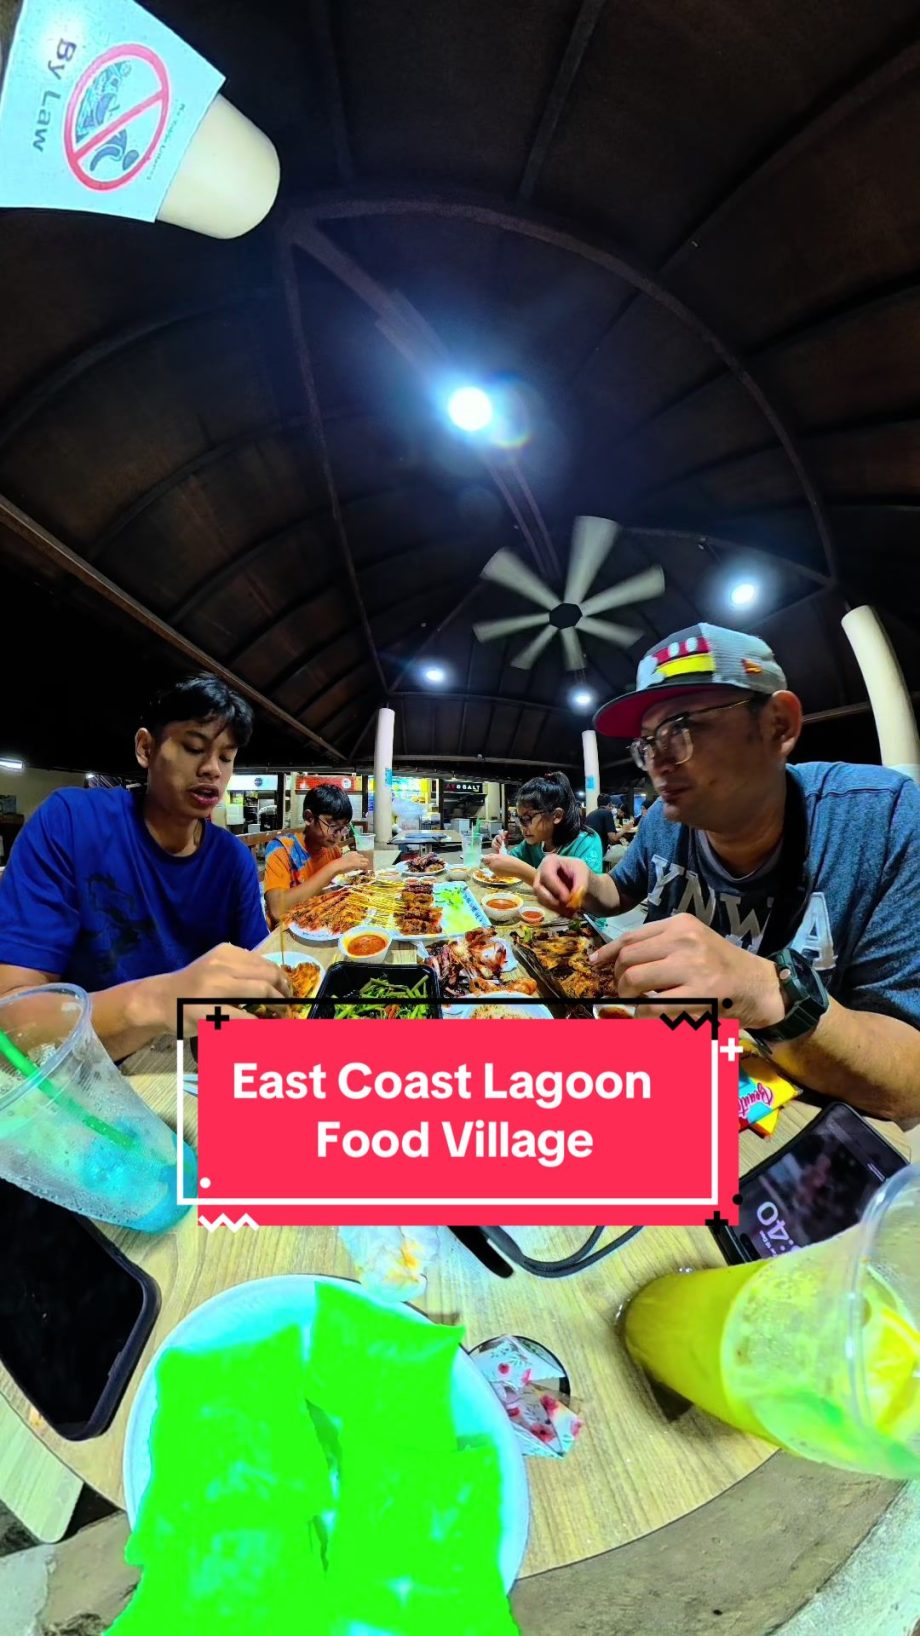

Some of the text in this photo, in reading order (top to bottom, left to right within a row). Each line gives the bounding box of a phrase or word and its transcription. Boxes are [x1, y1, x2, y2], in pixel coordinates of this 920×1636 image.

[33, 38, 77, 152] By Law
[757, 1201, 800, 1250] :40
